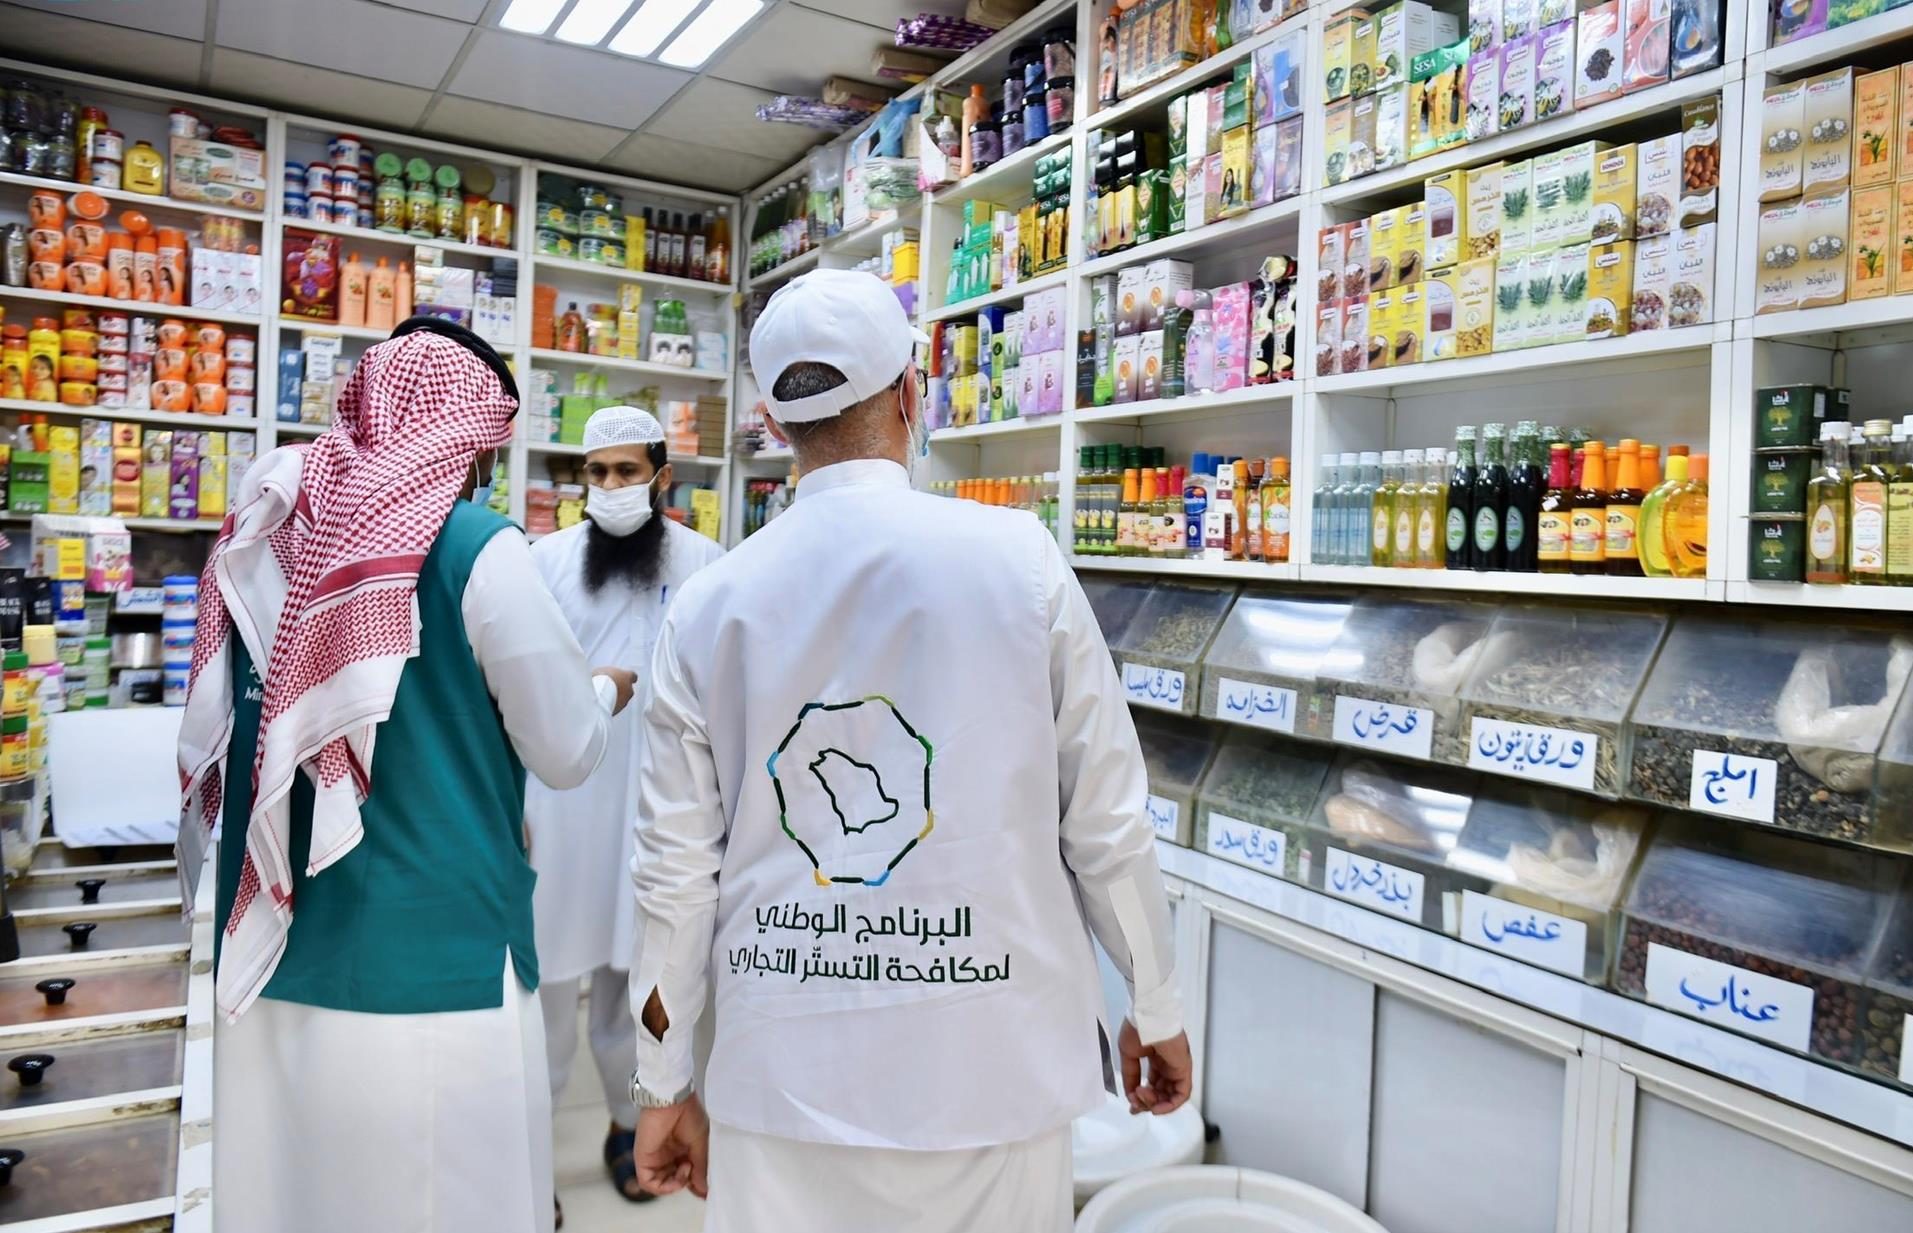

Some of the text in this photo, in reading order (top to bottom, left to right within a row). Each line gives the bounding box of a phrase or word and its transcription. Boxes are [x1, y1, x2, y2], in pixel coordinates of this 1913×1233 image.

[1352, 706, 1418, 739] قرض
[1478, 729, 1532, 771] زيتون
[755, 901, 972, 946] البرنامج الوطني
[1481, 908, 1562, 943] عفص
[728, 943, 797, 977] التجاري
[885, 953, 1011, 984] لمكافحة
[1679, 973, 1782, 1023] عناب
